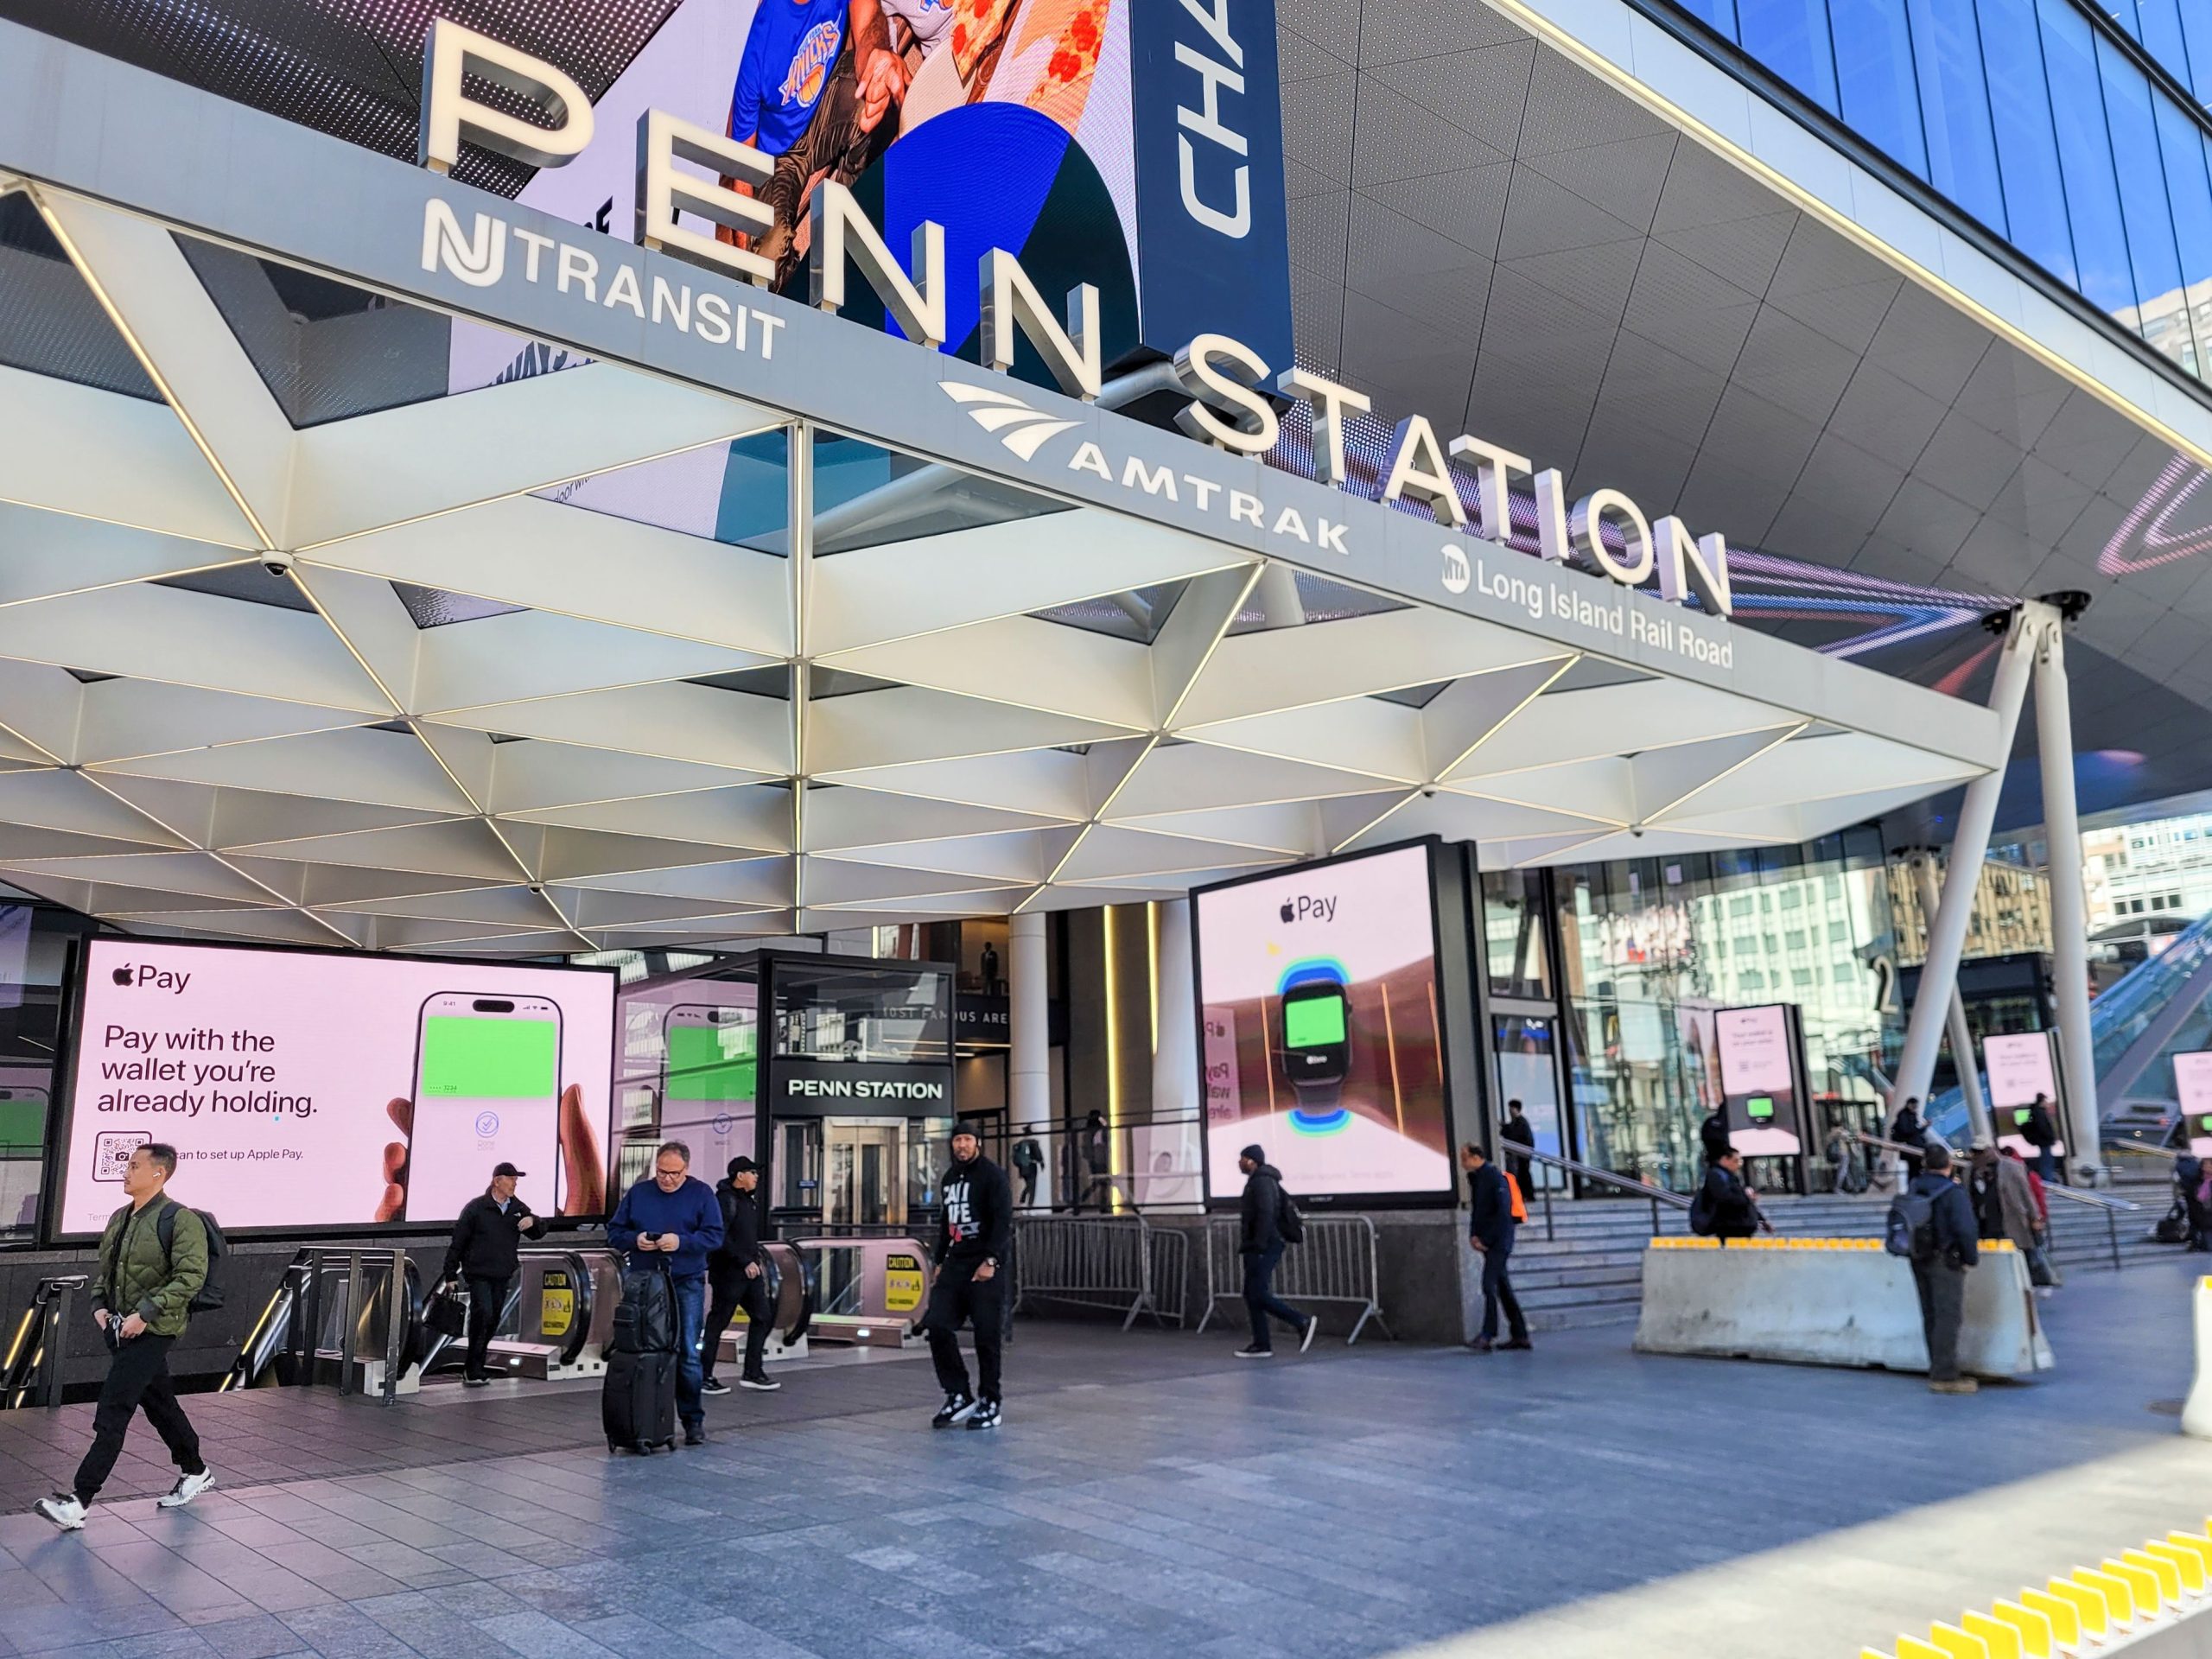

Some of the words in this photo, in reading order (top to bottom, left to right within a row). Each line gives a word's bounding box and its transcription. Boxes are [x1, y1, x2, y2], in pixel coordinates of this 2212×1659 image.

[779, 22, 840, 105] KNICKS
[421, 198, 507, 288] NJ
[513, 226, 785, 360] TRANSIT
[418, 17, 1102, 400] PENN
[1173, 333, 1733, 617] STATION
[1066, 441, 1350, 556] AMTRAK
[1440, 549, 1468, 585] MTA
[1477, 559, 1542, 619] Long
[1549, 582, 1624, 636] Island
[1630, 609, 1673, 652] Rail
[1679, 625, 1733, 670] Road
[1297, 895, 1337, 922] Pay
[137, 964, 191, 995] Pay
[1869, 955, 1899, 1015] 2
[921, 1007, 976, 1023] FAMUS
[982, 1013, 1008, 1025] ARE
[104, 1025, 158, 1054] Pay
[165, 1027, 224, 1051] with
[231, 1029, 275, 1052] the
[101, 1058, 187, 1081] wallet
[193, 1059, 276, 1086] you're
[97, 1089, 206, 1117] already
[212, 1090, 318, 1118] holding.
[788, 1079, 851, 1097] PENN
[855, 1080, 943, 1099] STATION
[196, 1150, 207, 1160] to
[210, 1150, 227, 1160] set
[230, 1151, 245, 1161] up
[247, 1148, 280, 1161] Apple
[282, 1148, 303, 1161] Pay.
[88, 1212, 111, 1222] Term
[948, 1202, 972, 1224] IFE
[888, 1256, 914, 1269] CAUTION
[544, 1273, 566, 1287] CAUTION
